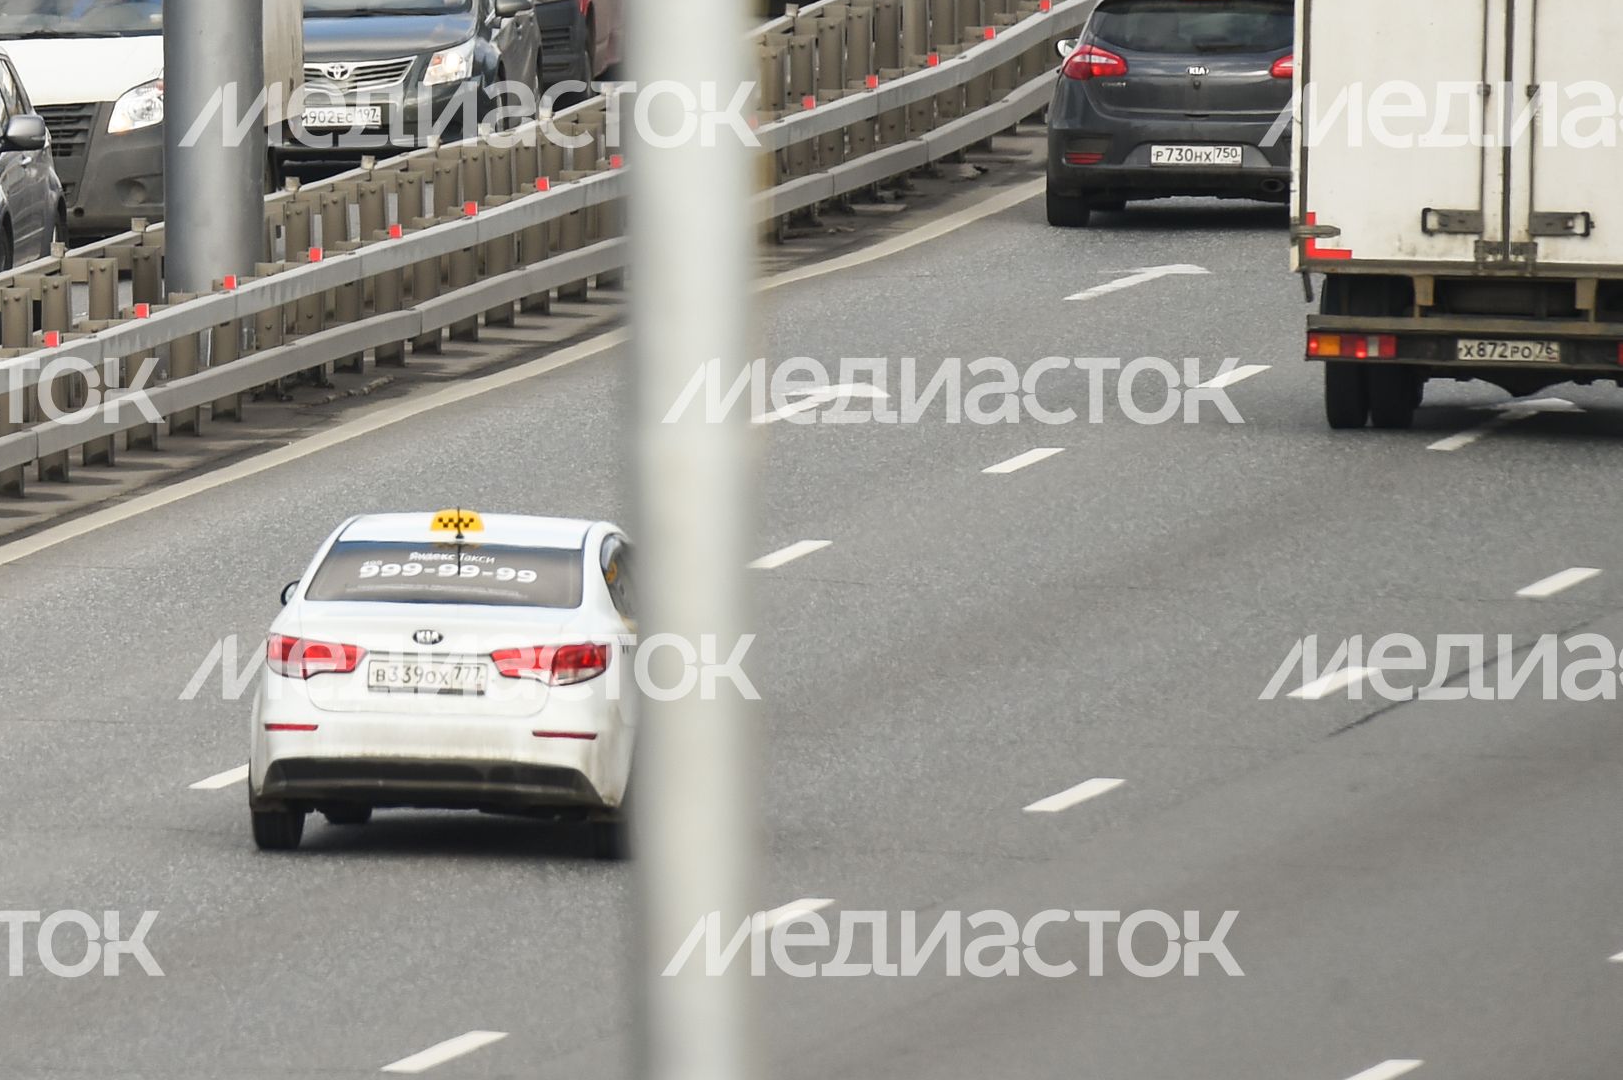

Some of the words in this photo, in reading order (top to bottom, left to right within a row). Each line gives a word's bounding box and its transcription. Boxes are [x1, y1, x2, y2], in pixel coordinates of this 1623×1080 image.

[1188, 66, 1209, 75] KIA
[1155, 147, 1212, 162] Р730НХ
[1215, 148, 1239, 159] 750
[1464, 342, 1533, 359] Х872РО
[1537, 341, 1553, 356] 76
[358, 562, 538, 584] 999-99-99
[416, 630, 441, 644] KIA
[376, 666, 449, 685] В339ОХ
